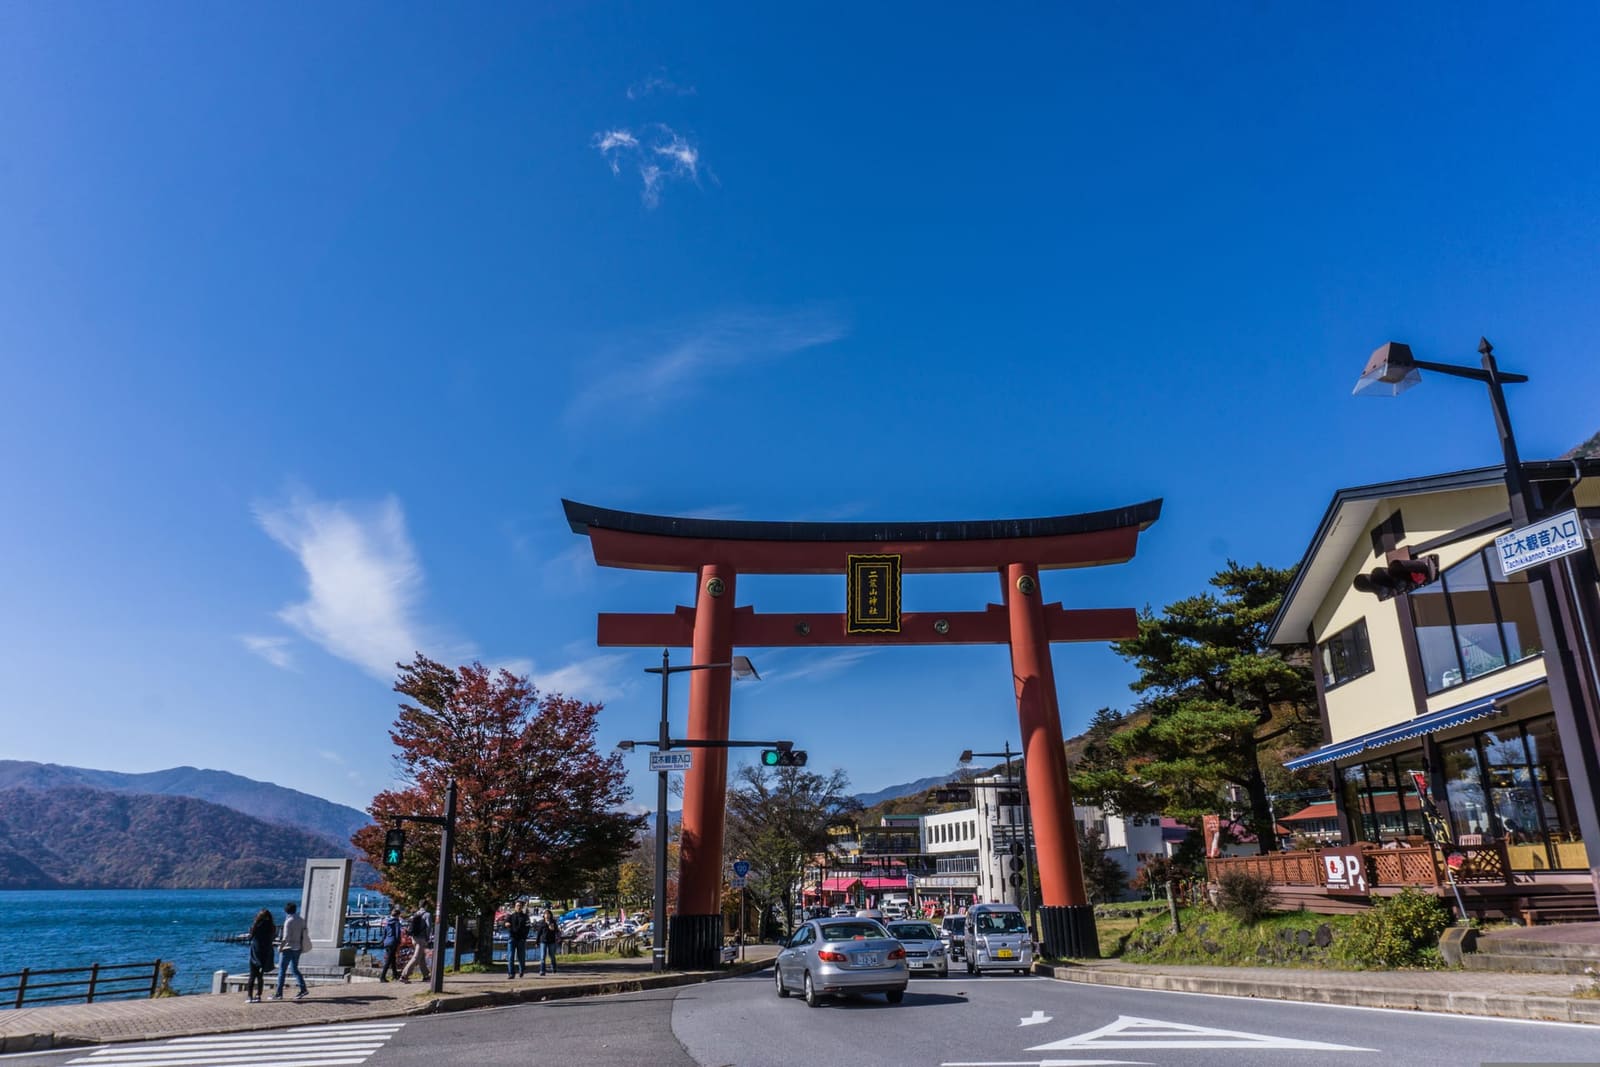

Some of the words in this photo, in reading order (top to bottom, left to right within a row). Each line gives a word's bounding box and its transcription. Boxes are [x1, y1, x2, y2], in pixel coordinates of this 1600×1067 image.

[1502, 521, 1577, 559] 立木観音入口
[1506, 551, 1545, 568] Tachikikannon
[1547, 544, 1566, 556] Statue
[1346, 856, 1360, 886] P
